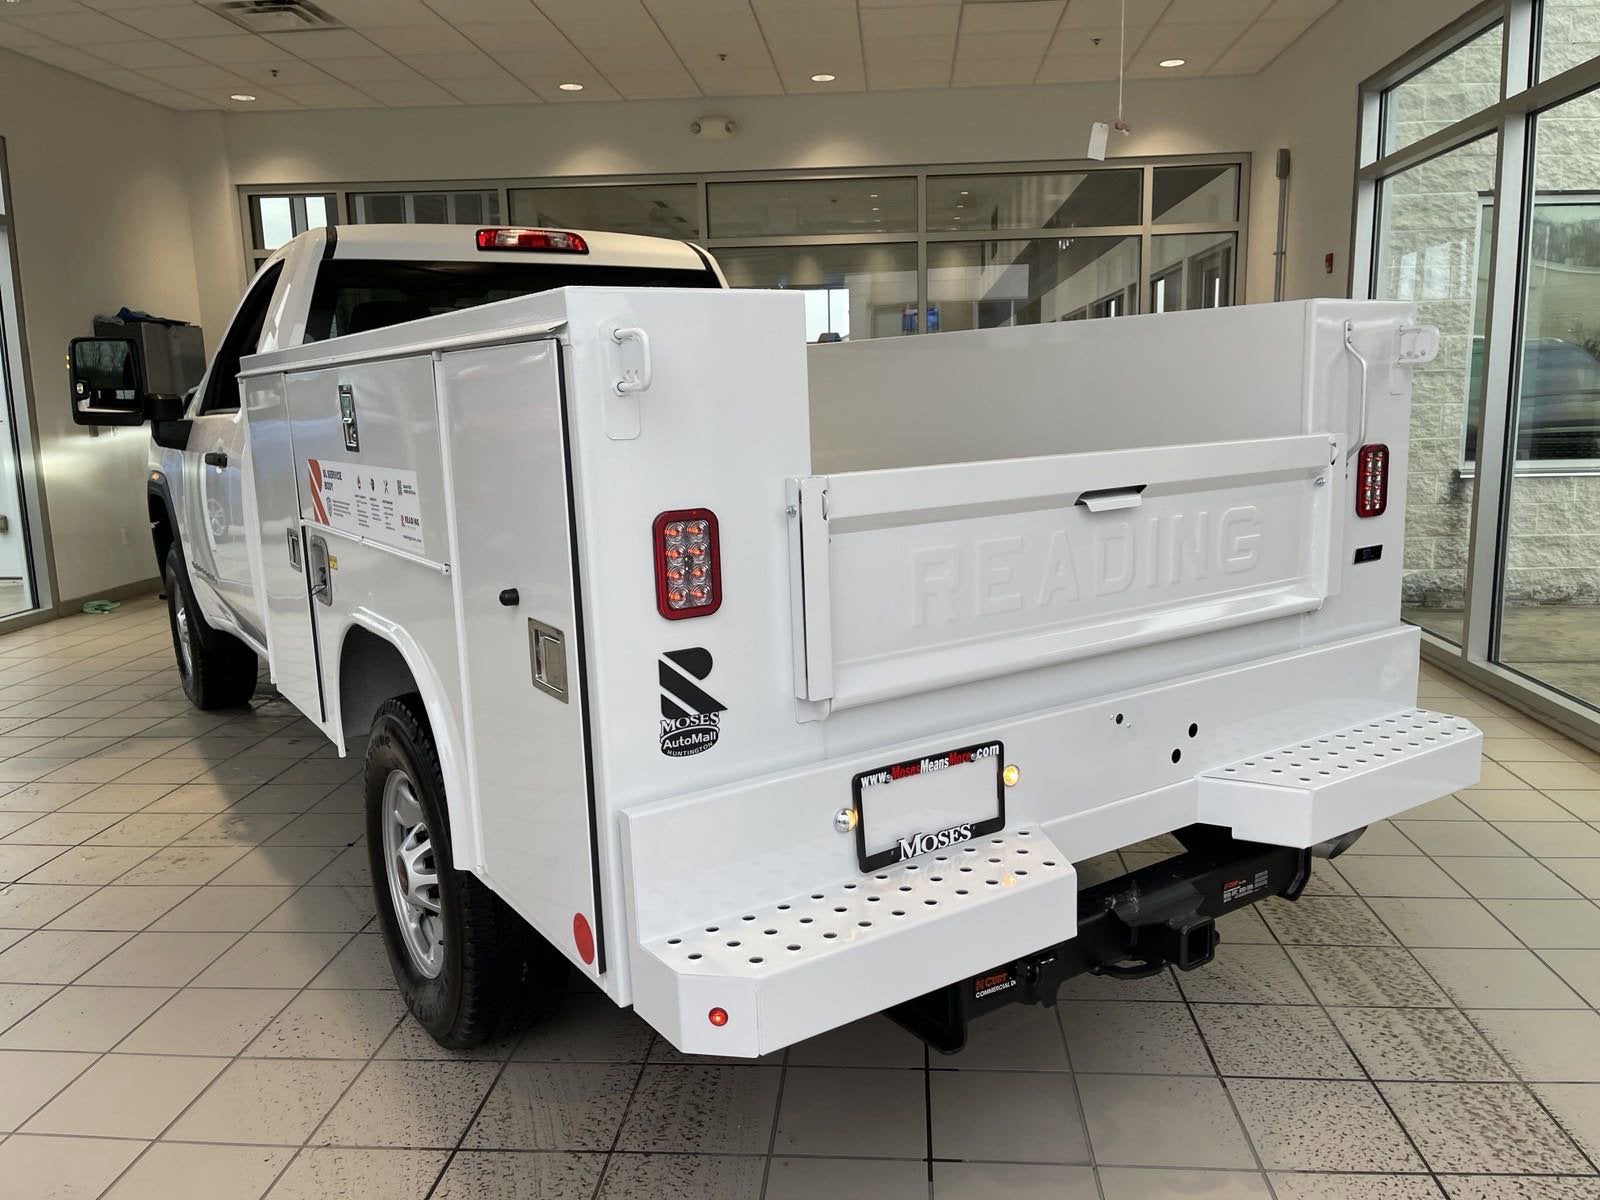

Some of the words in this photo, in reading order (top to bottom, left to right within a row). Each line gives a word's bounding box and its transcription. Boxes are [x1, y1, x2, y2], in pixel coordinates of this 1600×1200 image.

[911, 504, 1262, 628] READING
[660, 711, 720, 737] MOSES
[663, 731, 717, 750] AutoMall
[666, 742, 713, 757] HUNTINGTON
[898, 823, 972, 862] MOSES
[976, 982, 1010, 998] COMMERCIAL
